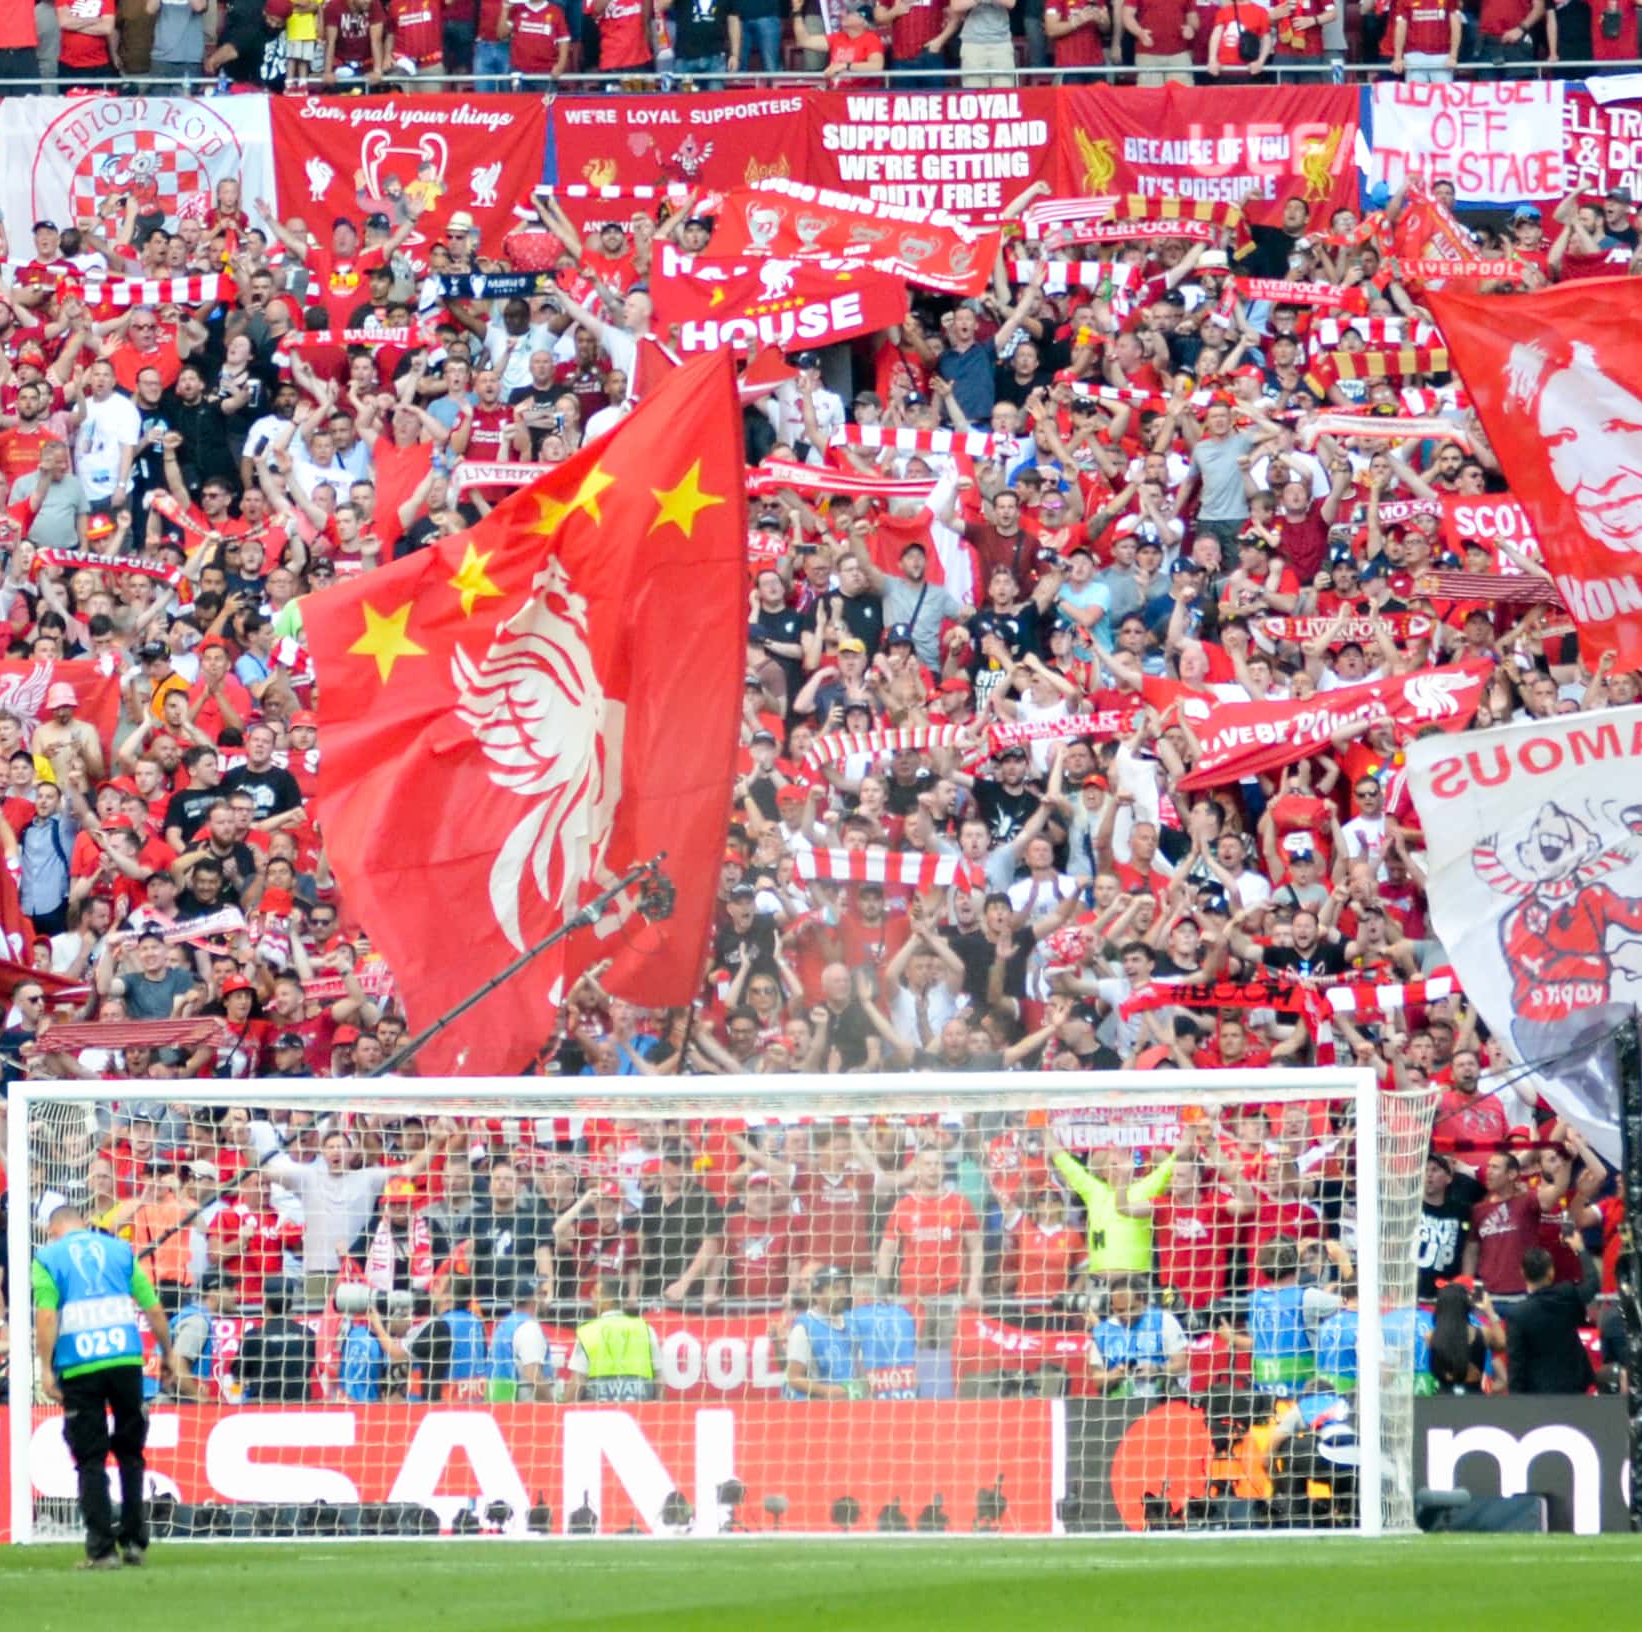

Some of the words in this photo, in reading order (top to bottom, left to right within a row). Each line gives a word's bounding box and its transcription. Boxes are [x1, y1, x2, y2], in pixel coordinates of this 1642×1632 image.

[300, 97, 347, 122] Son,
[350, 100, 397, 128] grab
[401, 106, 447, 128] your
[451, 101, 513, 128] things
[565, 108, 617, 126] WE'RE
[626, 108, 682, 125] LOYAL
[690, 96, 803, 125] SUPPORTERS
[847, 95, 889, 121] WE
[892, 94, 942, 121] ARE
[947, 93, 1022, 121] LOYAL
[822, 121, 989, 151] SUPPORTERS
[993, 119, 1047, 147] AND
[1430, 110, 1508, 151] OFF
[1124, 135, 1214, 164] BECAUSE
[1216, 137, 1244, 165] OF
[1248, 134, 1290, 163] YOU
[838, 153, 910, 181] WE'RE
[914, 151, 1029, 179] GETTING
[869, 181, 936, 209] DUTY
[941, 180, 1001, 210] FREE
[1076, 221, 1182, 238] LIVERPOOL
[1404, 261, 1519, 277] LIVERPOOL
[681, 292, 865, 353] HOUSE
[53, 549, 166, 574] LIVERPOOL
[75, 1328, 127, 1357] 029
